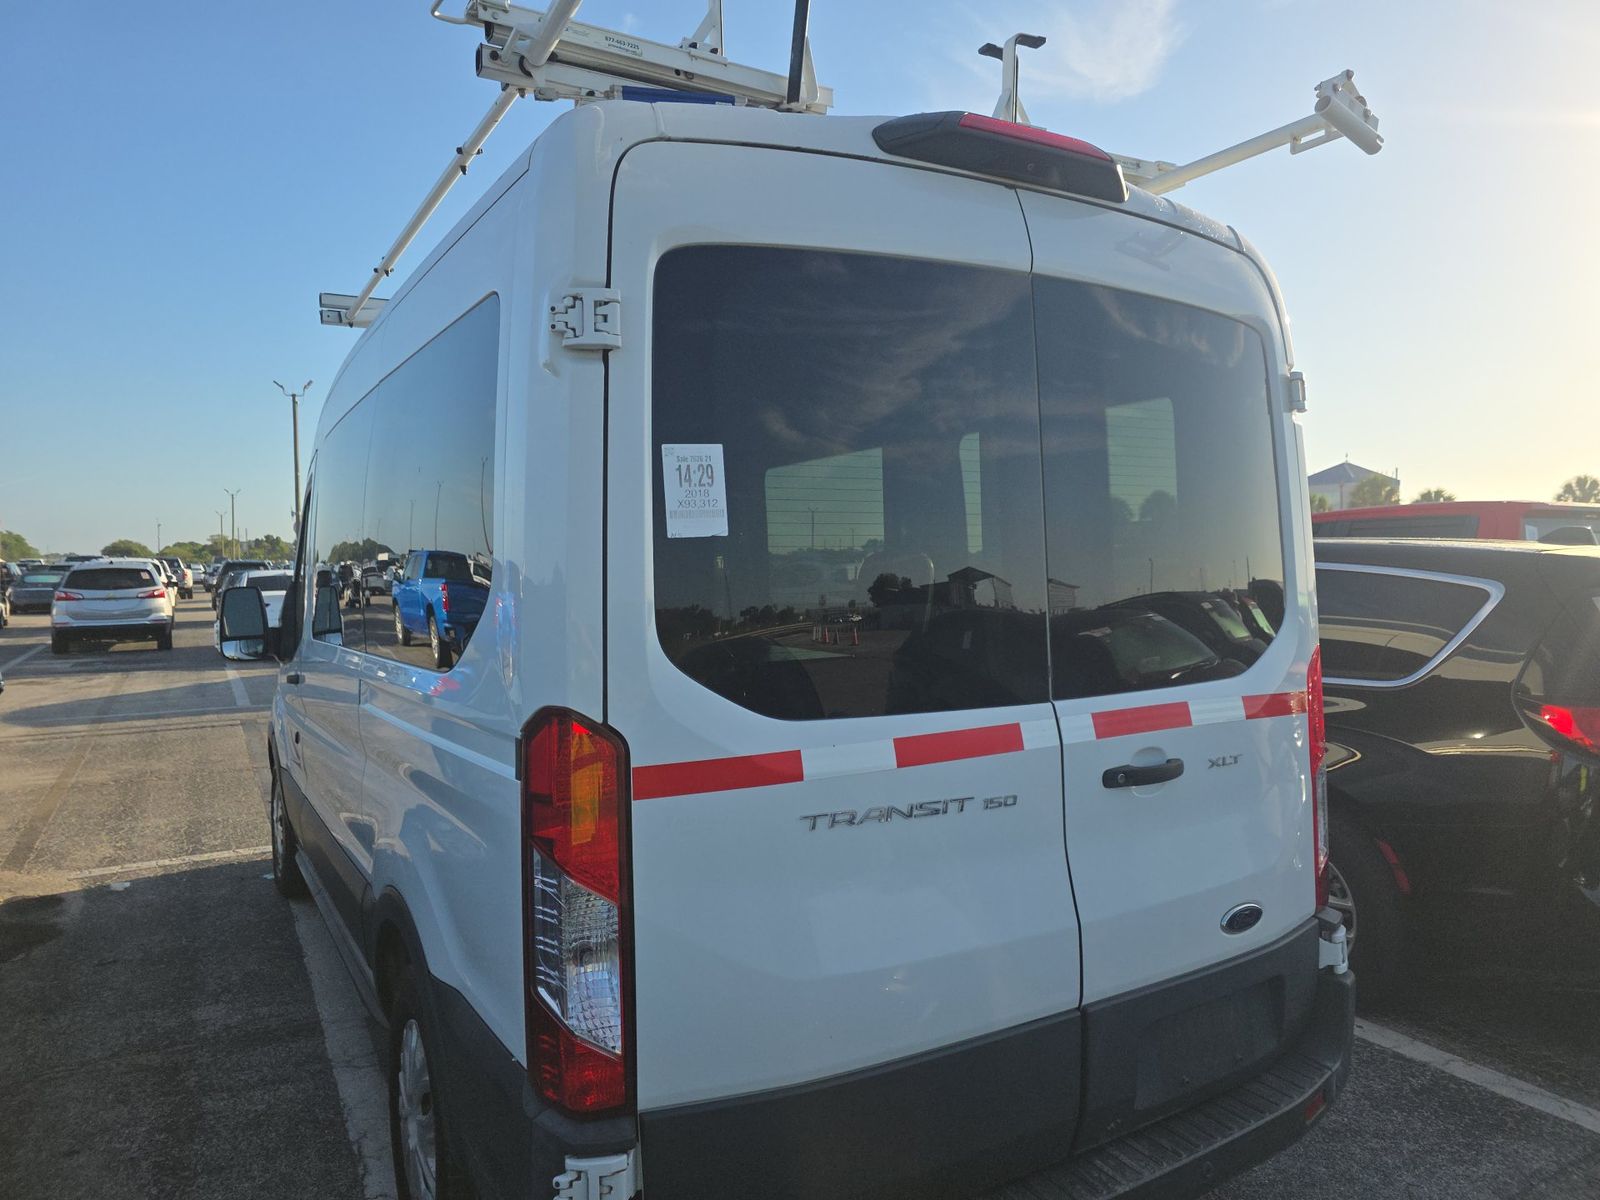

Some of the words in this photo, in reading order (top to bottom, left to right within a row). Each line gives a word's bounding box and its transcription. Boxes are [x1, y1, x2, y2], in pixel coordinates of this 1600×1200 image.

[676, 463, 714, 488] 14:29
[684, 489, 710, 499] 2018
[678, 499, 719, 509] X93,312
[1207, 754, 1243, 769] XLT
[799, 796, 975, 832] TRANSIT
[982, 794, 1018, 811] 150
